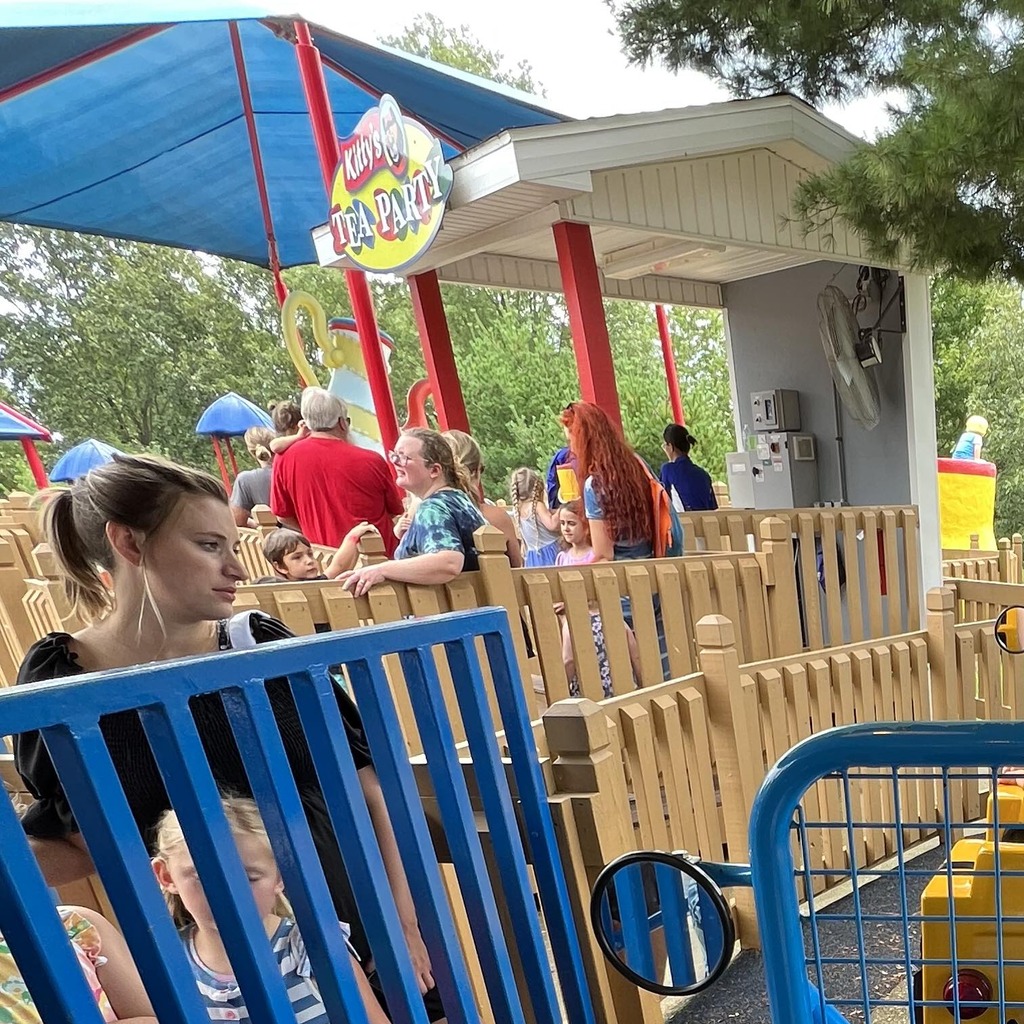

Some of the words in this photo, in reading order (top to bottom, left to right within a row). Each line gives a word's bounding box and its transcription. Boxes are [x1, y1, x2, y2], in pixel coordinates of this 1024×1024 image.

[344, 124, 382, 180] Kitty's
[332, 201, 373, 247] TEA
[375, 156, 443, 234] PARTY
